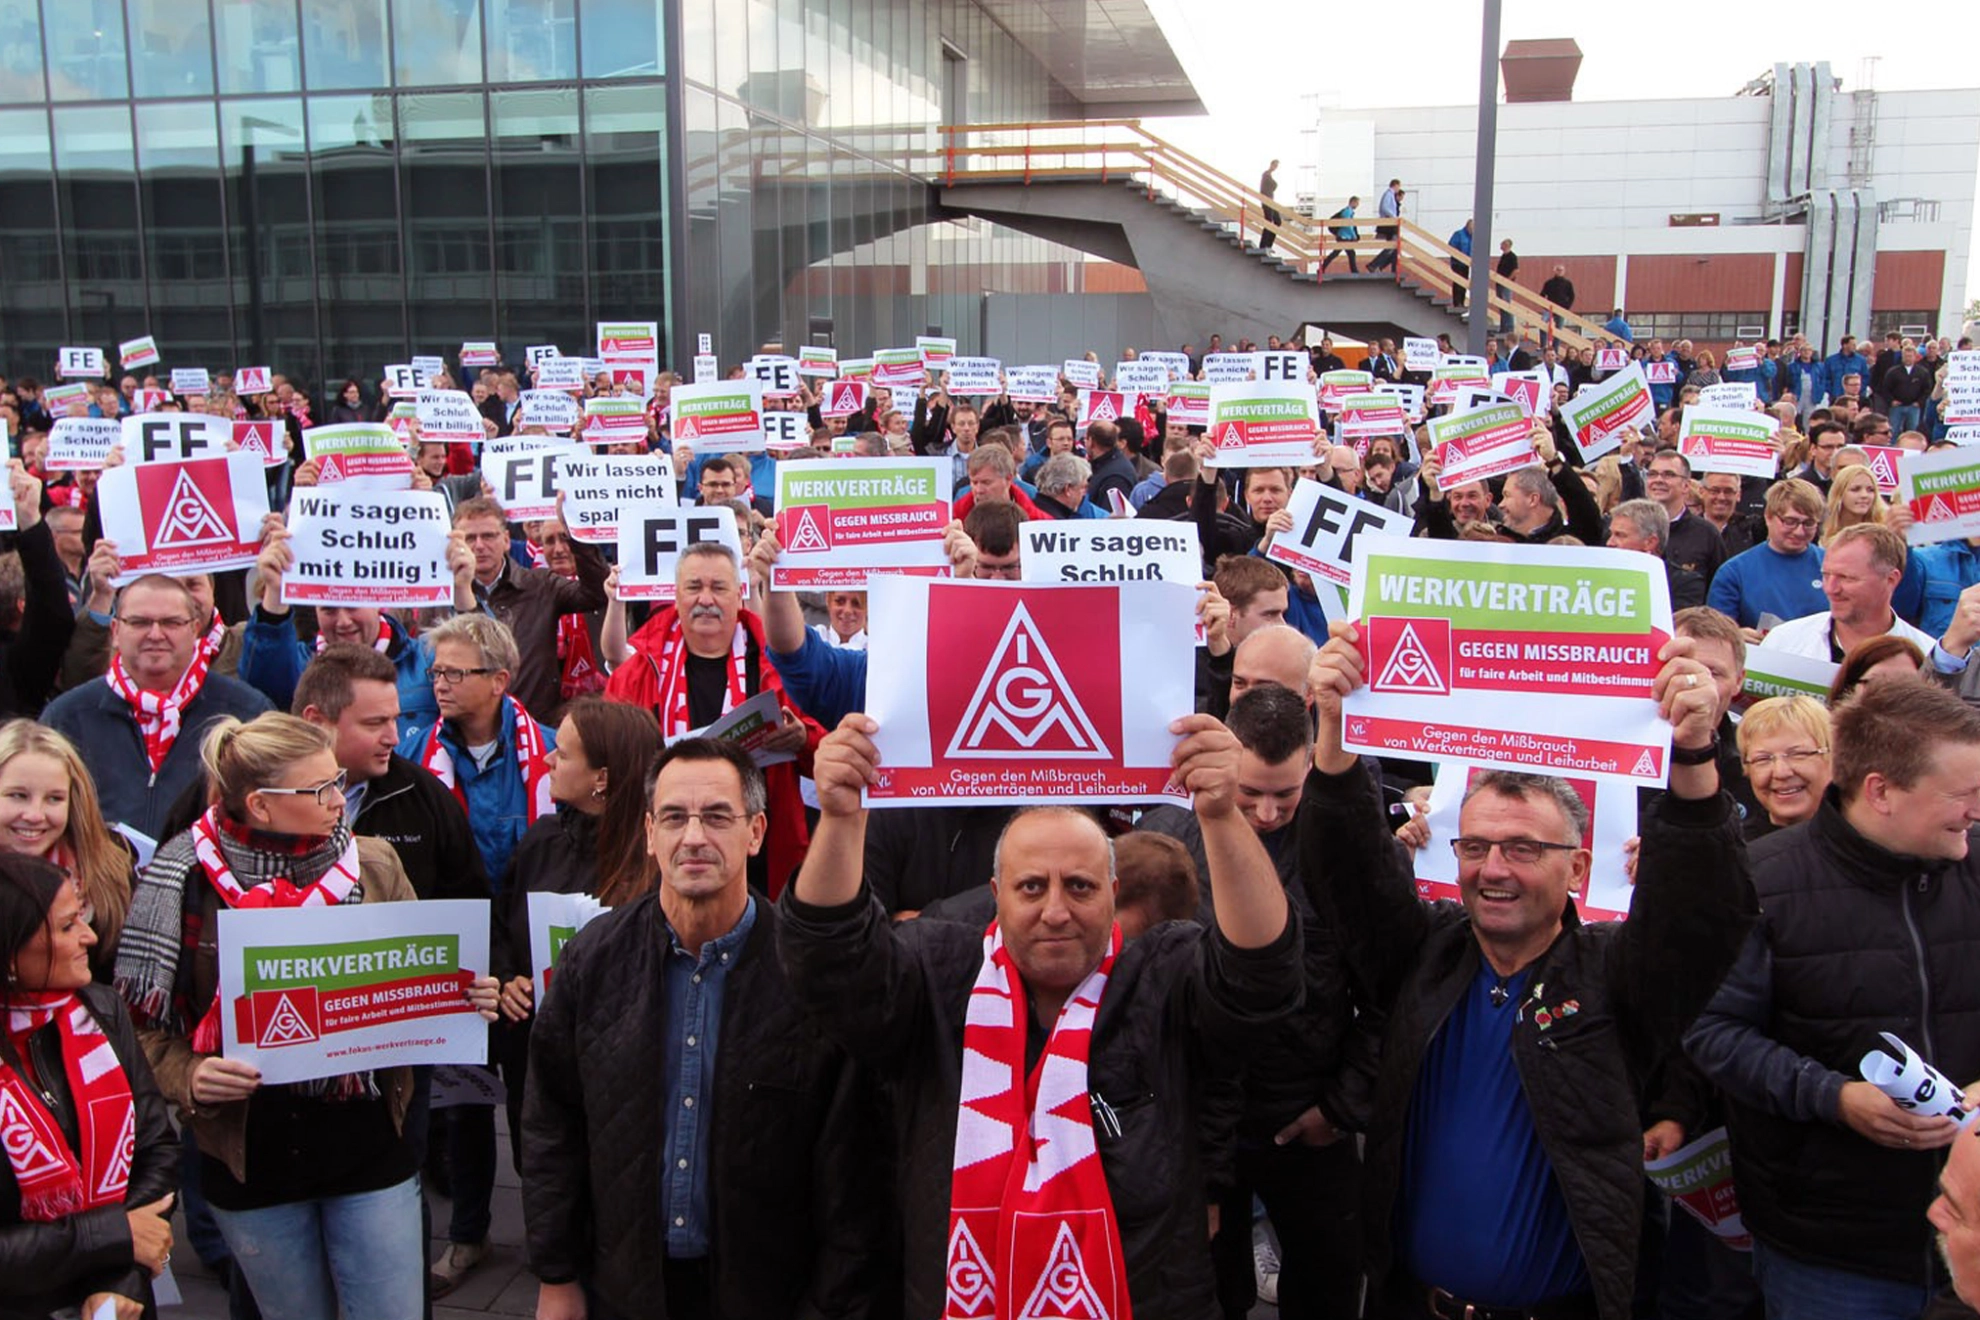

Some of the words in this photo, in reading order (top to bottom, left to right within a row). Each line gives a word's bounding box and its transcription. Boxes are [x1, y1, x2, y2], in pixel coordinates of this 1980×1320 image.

[69, 352, 94, 368] FE
[1264, 356, 1297, 380] FE
[396, 369, 425, 388] FE
[421, 395, 440, 403] Wir
[524, 393, 541, 401] Wir
[681, 397, 747, 413] WERKVERTRÄGE
[433, 408, 470, 416] Schluß
[1221, 403, 1304, 417] WERKVERTRÄGE
[424, 421, 442, 429] mit
[446, 422, 473, 431] billig
[545, 415, 569, 423] billig
[64, 436, 111, 445] Schluß
[1949, 431, 1968, 439] Wir
[53, 449, 75, 457] mit
[80, 449, 111, 459] billi
[491, 443, 514, 453] Wir
[566, 463, 599, 478] Wir
[606, 462, 668, 477] lassen
[574, 488, 609, 500] uns
[616, 485, 664, 499] nicht
[789, 475, 928, 498] WERKVERTRÄGE
[300, 498, 341, 517] Wir
[350, 504, 442, 525] sagen:
[579, 507, 619, 525] spal
[834, 515, 868, 528] GEGEN
[870, 511, 938, 525] MISSBRAUCH
[321, 529, 417, 550] Schluß
[862, 530, 882, 539] Arbeit
[883, 529, 896, 537] und
[1030, 532, 1081, 554] Wir
[1090, 533, 1188, 557] sagen:
[300, 560, 343, 578] mit
[353, 561, 421, 584] billig
[818, 569, 844, 579] Gegen
[846, 569, 861, 577] den
[1060, 563, 1163, 582] Schluß
[813, 577, 867, 586] Werkverträge
[1379, 574, 1637, 618] WERKVERTRÄGE
[1459, 641, 1519, 660] GEGEN
[1524, 643, 1650, 665] MISSBRAUCH
[1459, 667, 1476, 680] für
[1478, 667, 1506, 680] faire
[1508, 669, 1544, 682] Arbeit
[1547, 671, 1569, 682] und
[1422, 727, 1466, 743] Gegen
[1469, 729, 1497, 745] den
[1501, 735, 1577, 753] Mißbrauch
[1384, 738, 1408, 748] von
[1411, 738, 1514, 760] Werkverträgen
[1516, 750, 1544, 764] und
[1547, 753, 1618, 771] Leiharbeit
[950, 769, 998, 785] Gegen
[1001, 769, 1027, 782] den
[1031, 769, 1106, 782] Mißbrauch
[911, 786, 936, 796] von
[940, 782, 1045, 797] Werkverträgen
[1049, 783, 1076, 795] und
[1079, 781, 1148, 795] Leiharbeit
[256, 943, 449, 981] WERKVERTRÄGE
[324, 995, 369, 1012] GEGEN
[372, 981, 460, 1004] MISSBRAUCH
[325, 1016, 338, 1027] für
[339, 1014, 360, 1026] faire
[361, 1009, 388, 1022] Arbeit
[389, 1006, 405, 1017] und
[326, 1036, 447, 1058] www.fokus-werkvertraege.de
